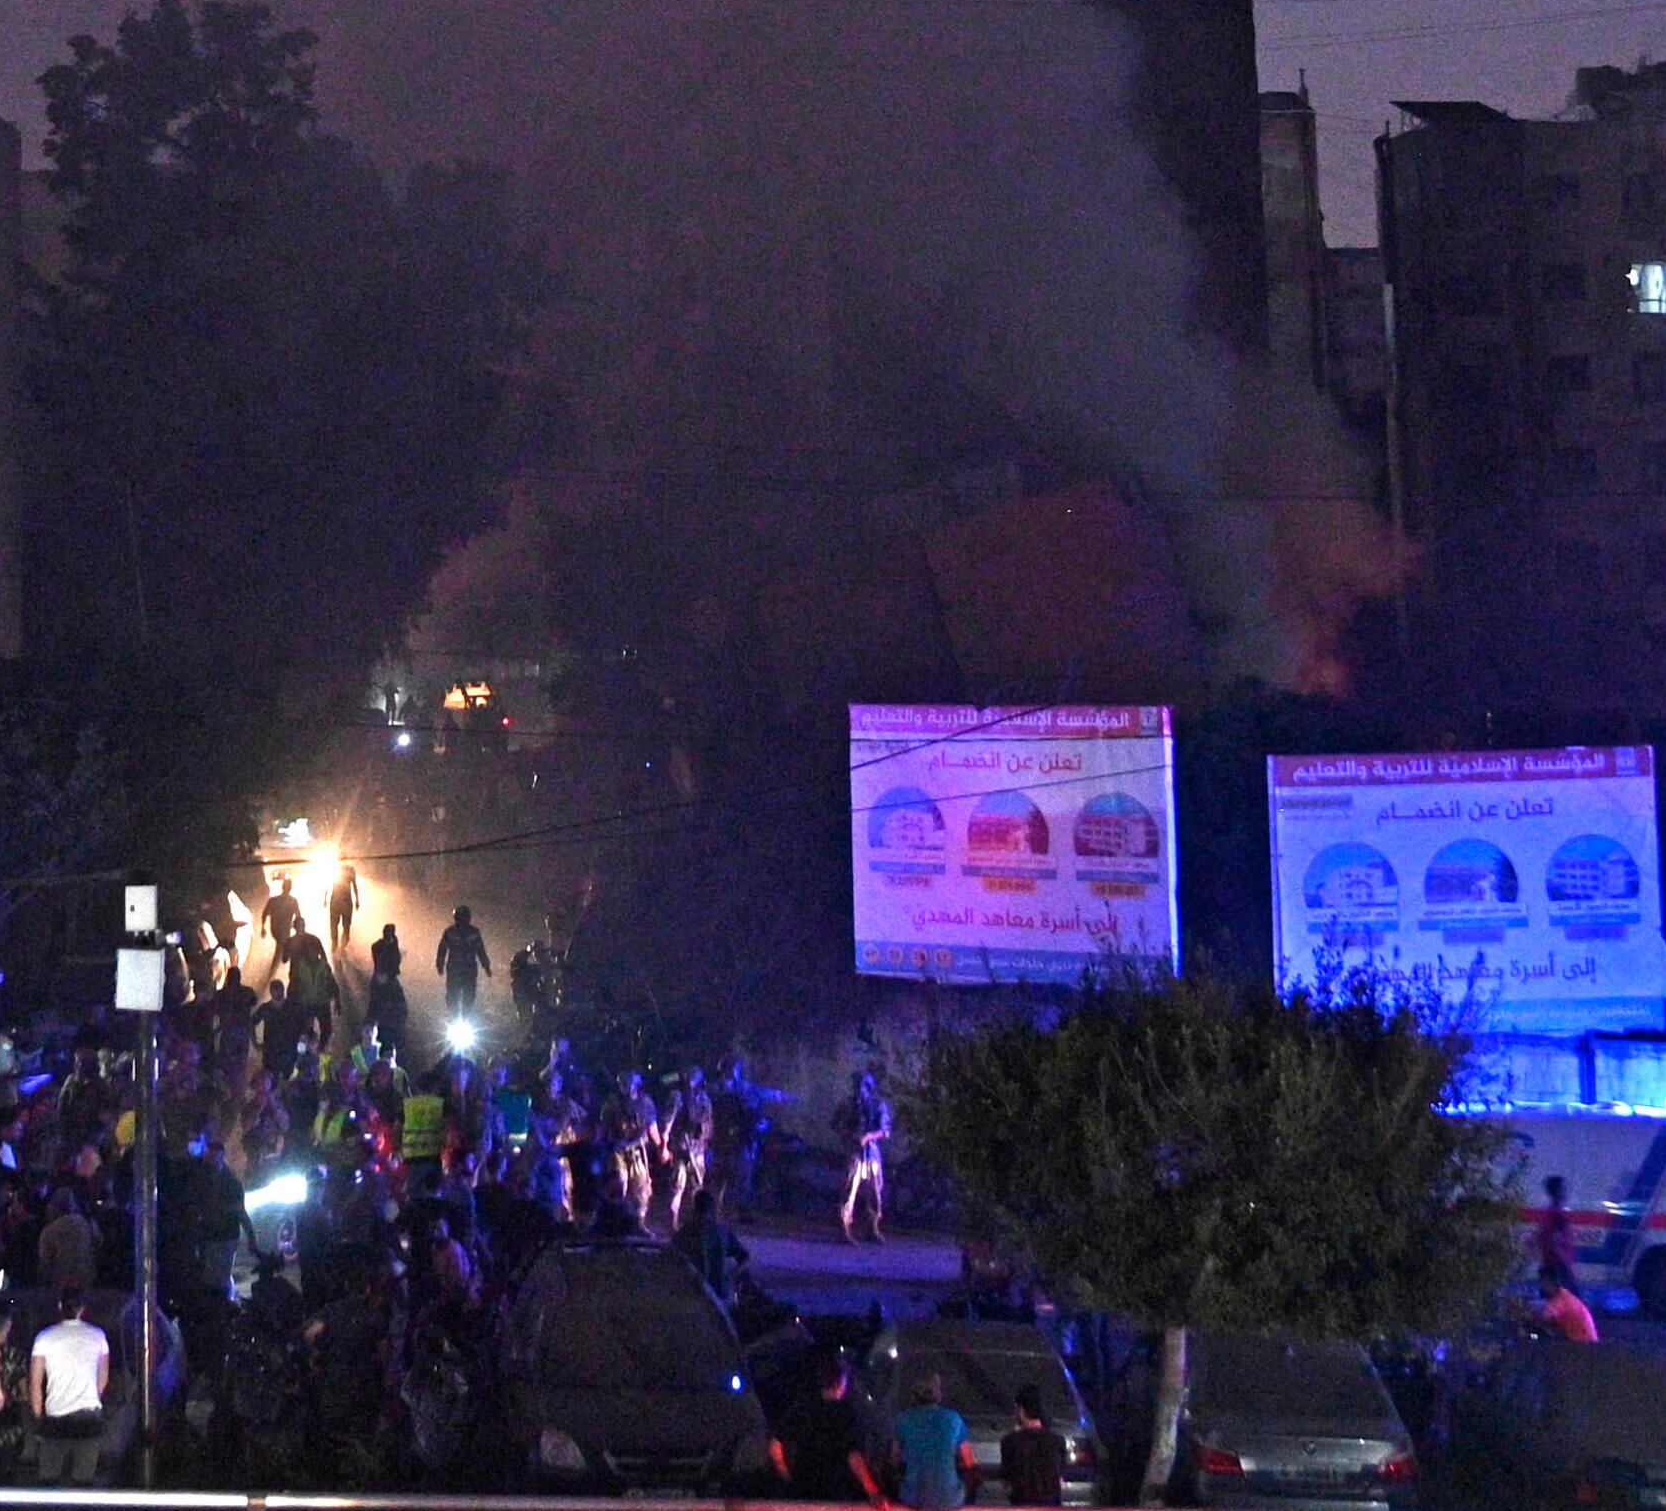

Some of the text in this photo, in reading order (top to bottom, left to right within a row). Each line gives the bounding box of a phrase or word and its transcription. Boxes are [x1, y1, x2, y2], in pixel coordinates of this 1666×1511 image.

[1007, 752, 1034, 773] عن
[1292, 760, 1368, 781] والتعليم
[1468, 798, 1499, 820] عن
